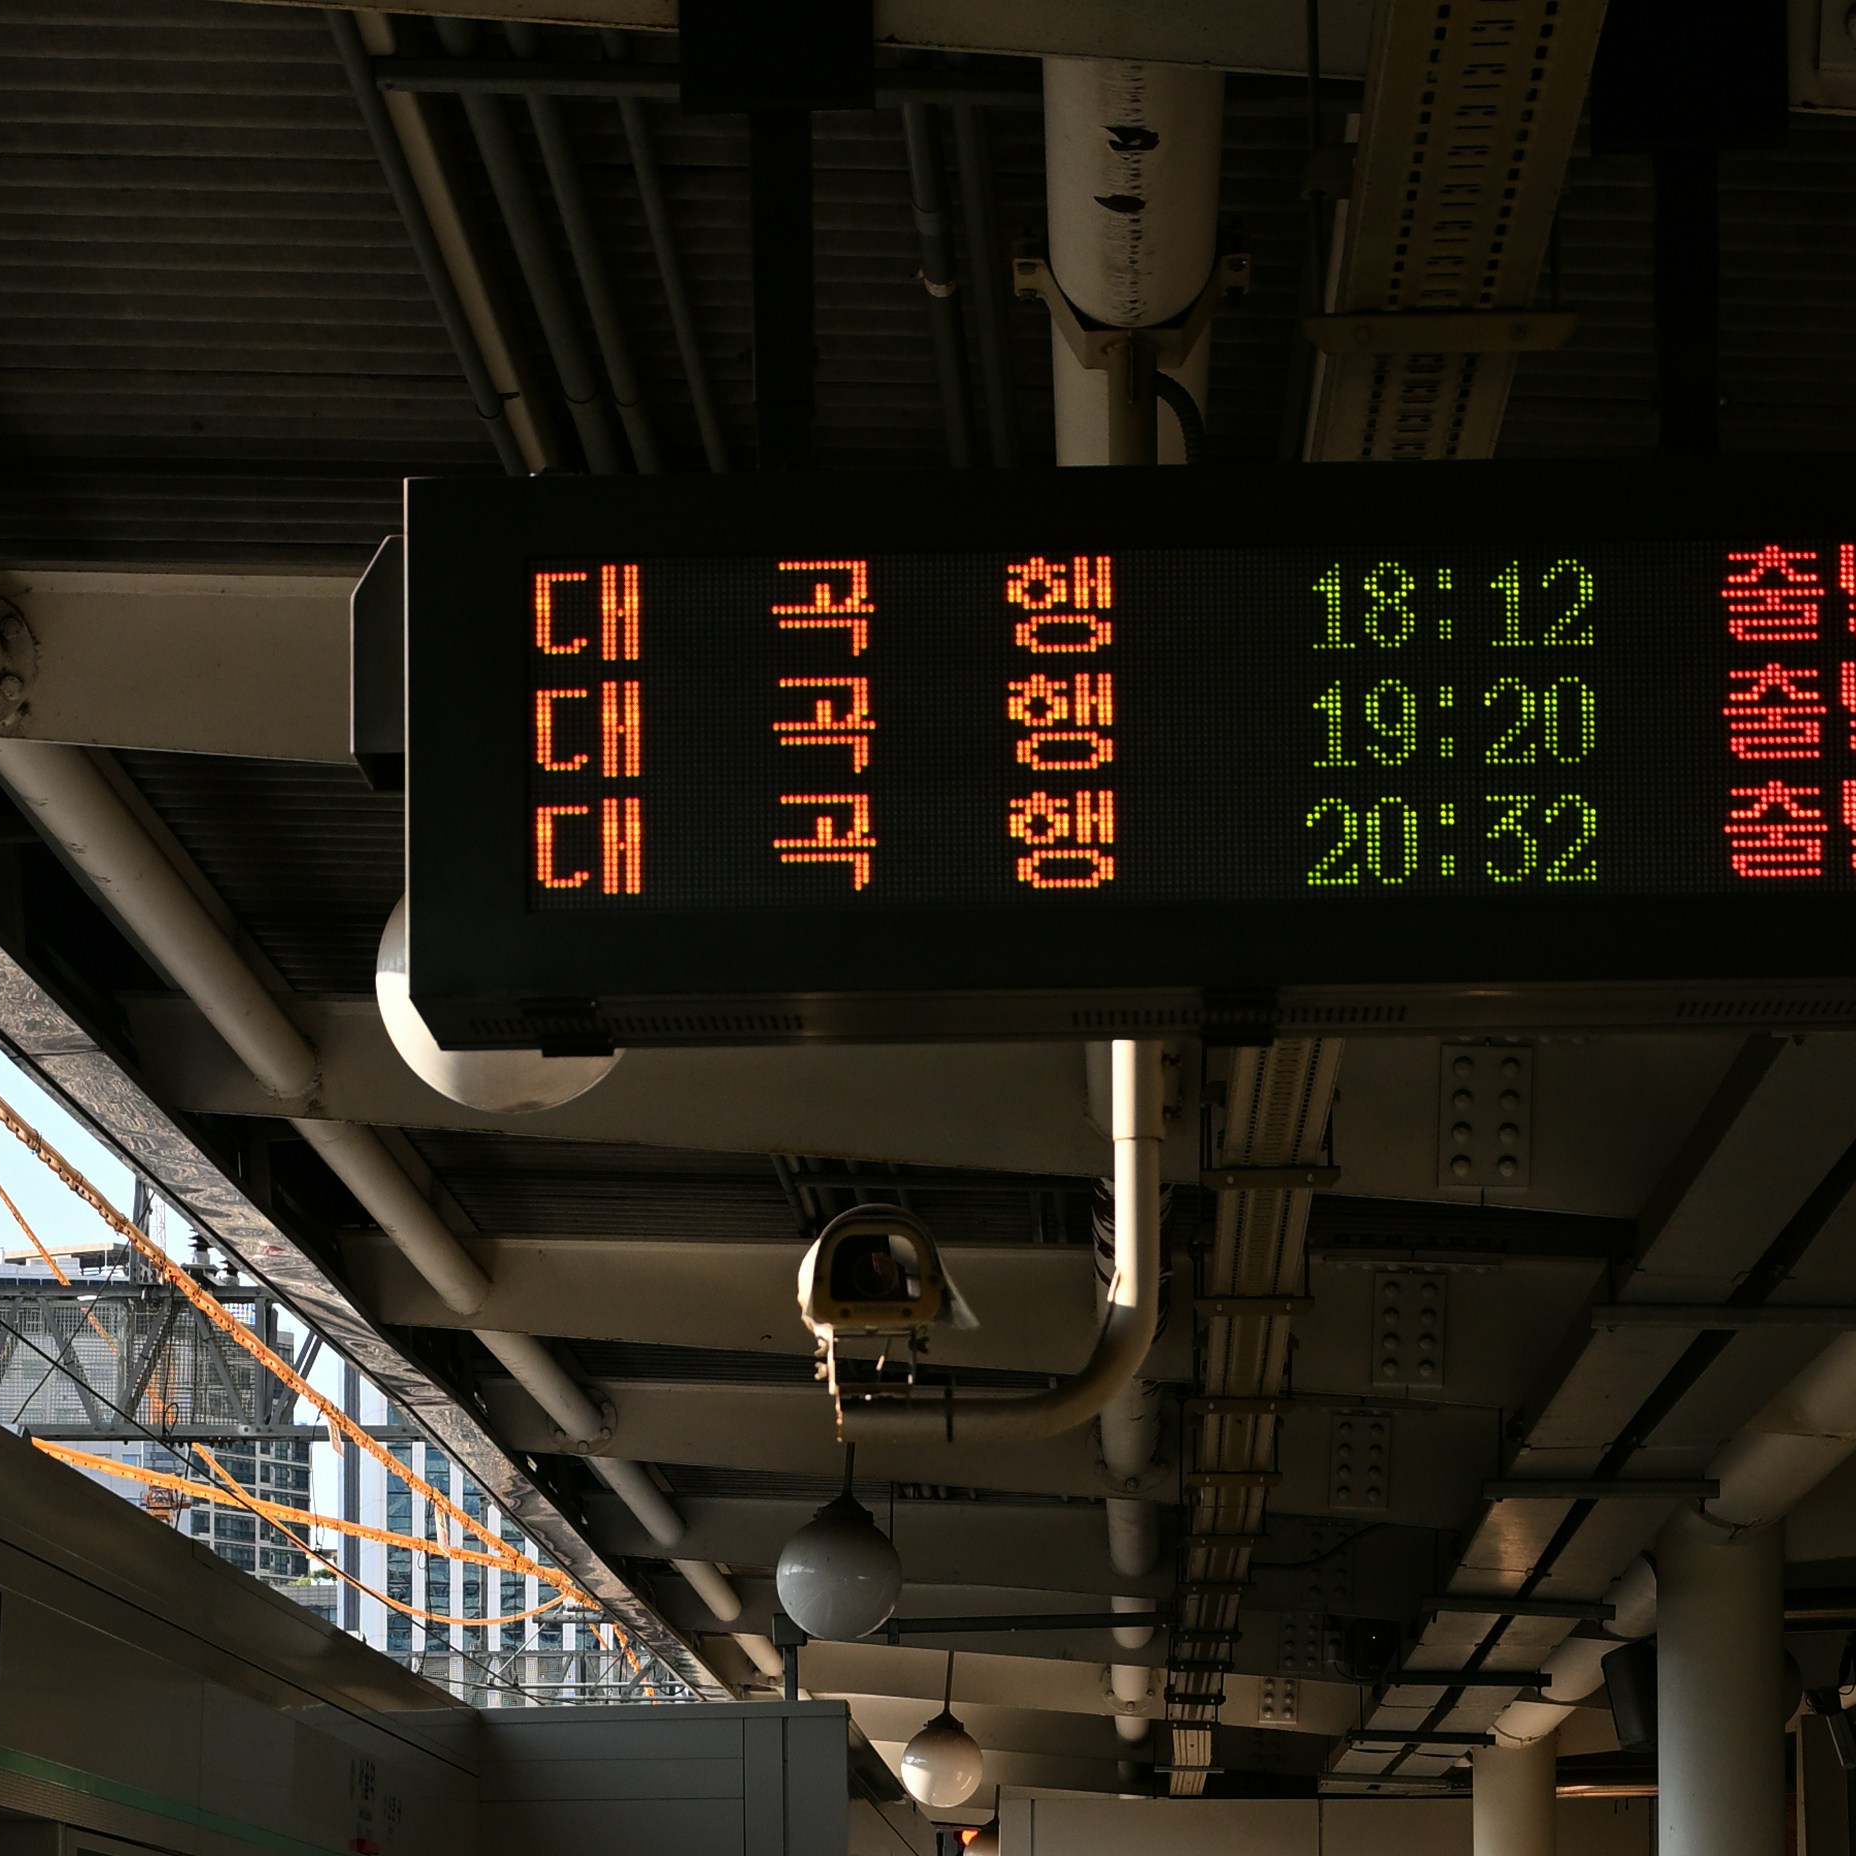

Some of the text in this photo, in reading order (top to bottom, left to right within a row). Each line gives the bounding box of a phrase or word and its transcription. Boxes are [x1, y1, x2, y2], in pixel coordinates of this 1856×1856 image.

[535, 564, 640, 660] 대
[771, 560, 875, 656] 곡
[1006, 556, 1112, 653] 행
[1313, 560, 1593, 648] 18:12
[536, 680, 640, 777] 대
[773, 677, 876, 773] 곡
[1008, 673, 1113, 770] 행
[1313, 677, 1594, 766] 19:20
[535, 797, 641, 894] 대
[773, 794, 877, 890] 곡
[1008, 790, 1115, 888] 행
[1307, 795, 1596, 885] 20:32
